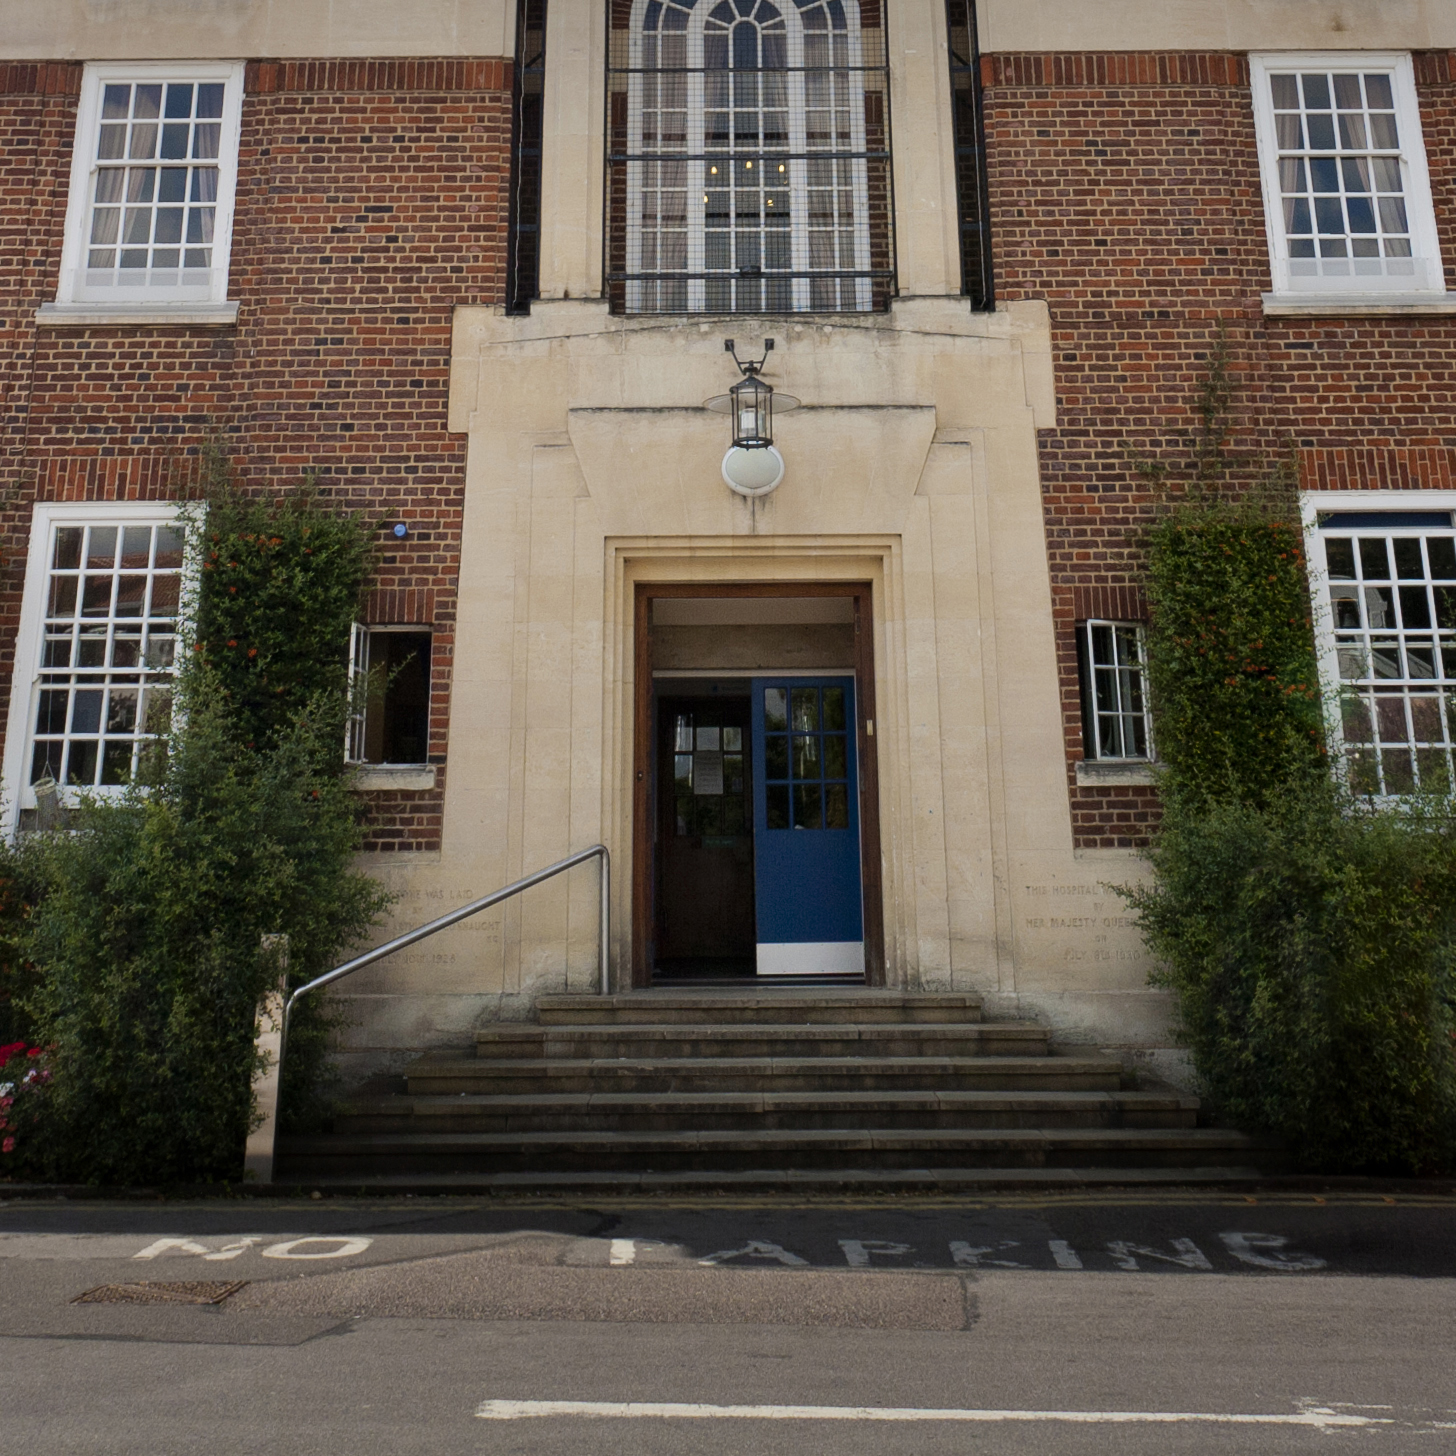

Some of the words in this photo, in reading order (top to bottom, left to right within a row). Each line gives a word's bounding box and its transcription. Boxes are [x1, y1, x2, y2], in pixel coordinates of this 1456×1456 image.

[426, 889, 445, 900] WAS
[449, 889, 474, 899] LAID
[1052, 885, 1099, 896] HOSPITAL
[1050, 917, 1097, 928] MAJESTY
[132, 1236, 373, 1261] NO
